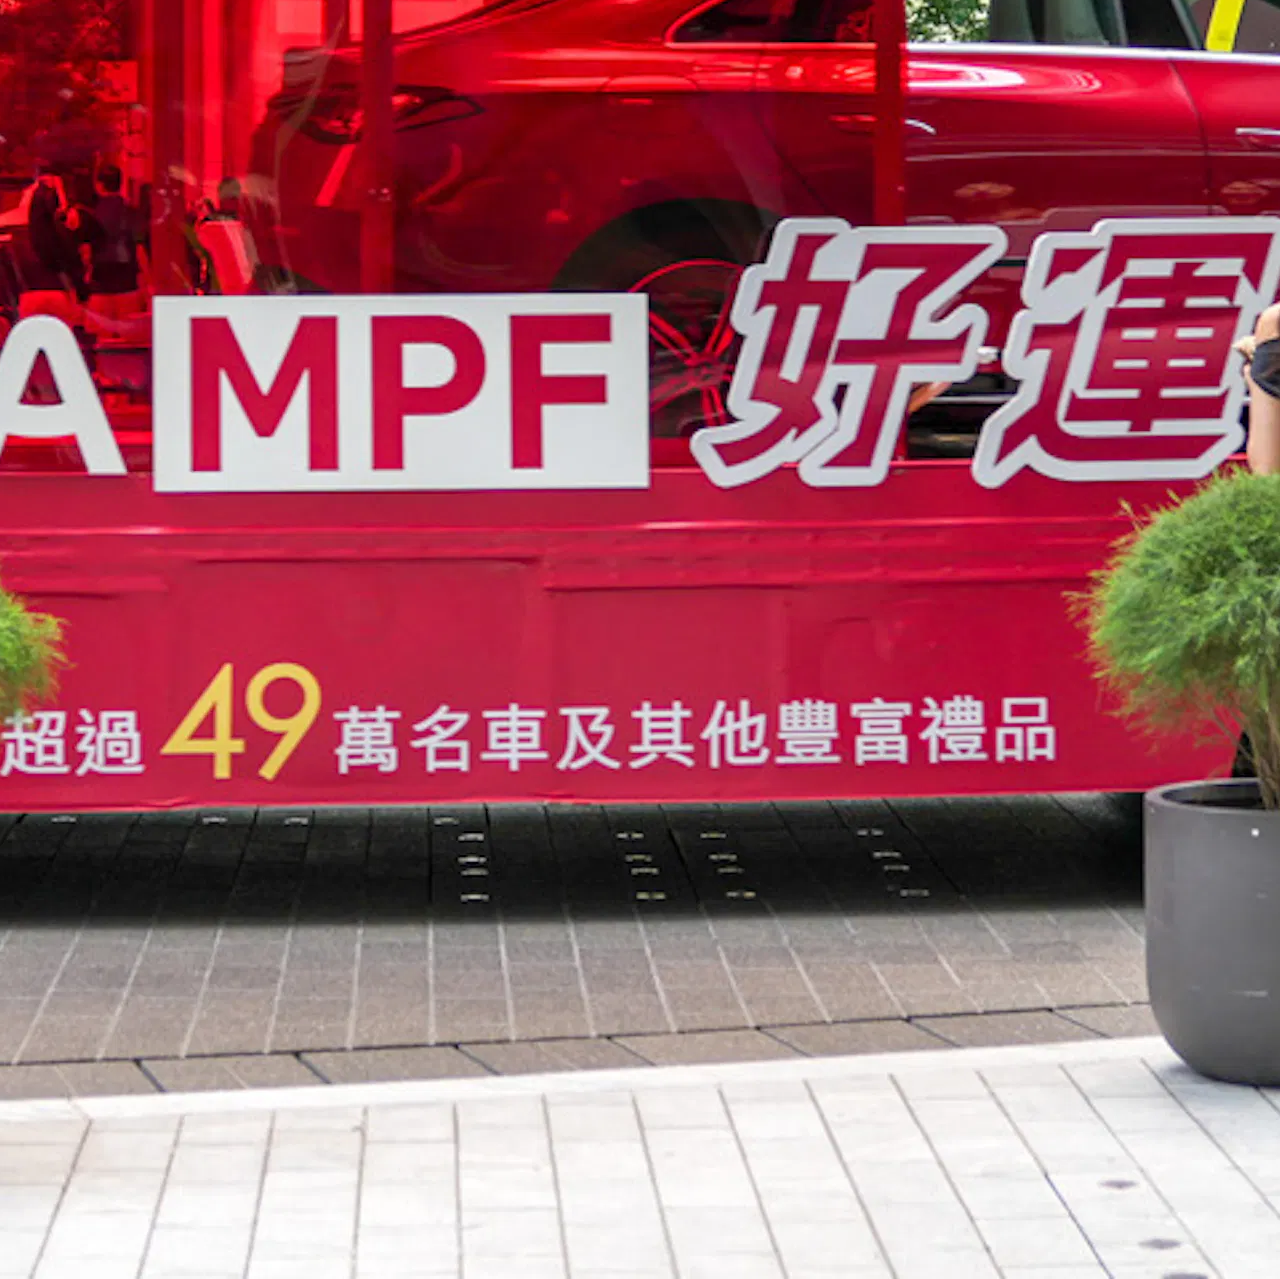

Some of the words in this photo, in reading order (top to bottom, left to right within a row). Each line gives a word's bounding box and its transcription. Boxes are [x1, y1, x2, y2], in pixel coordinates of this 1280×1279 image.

[189, 313, 613, 472] MPF
[160, 662, 322, 781] 49
[332, 696, 1056, 775] 萬名車及其他豐富禮品
